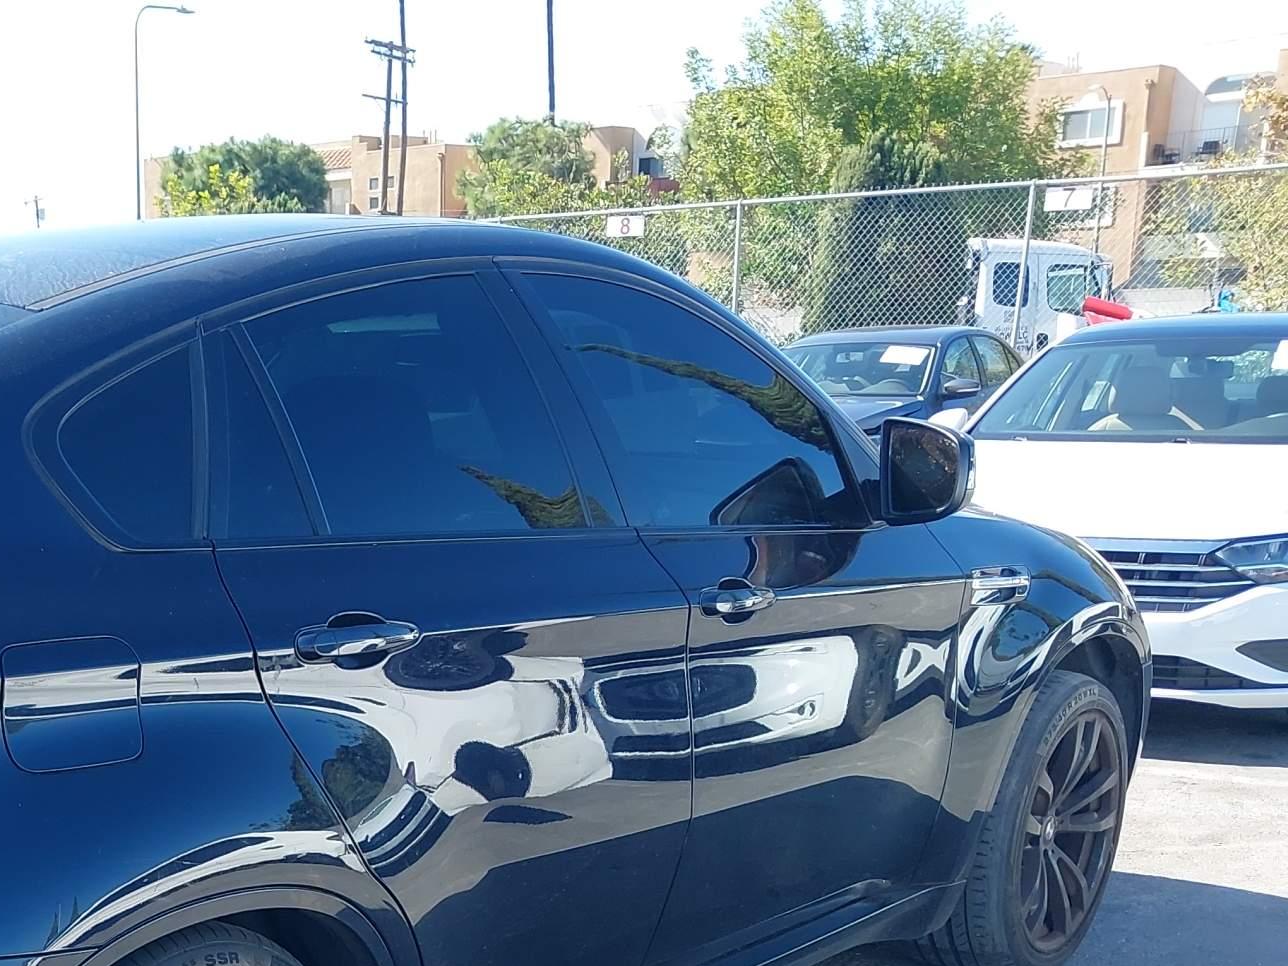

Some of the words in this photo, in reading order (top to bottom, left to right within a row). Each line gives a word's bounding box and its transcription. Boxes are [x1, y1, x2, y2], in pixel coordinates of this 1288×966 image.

[1063, 187, 1076, 208] 7
[620, 217, 630, 235] 8
[204, 951, 240, 966] SSR
